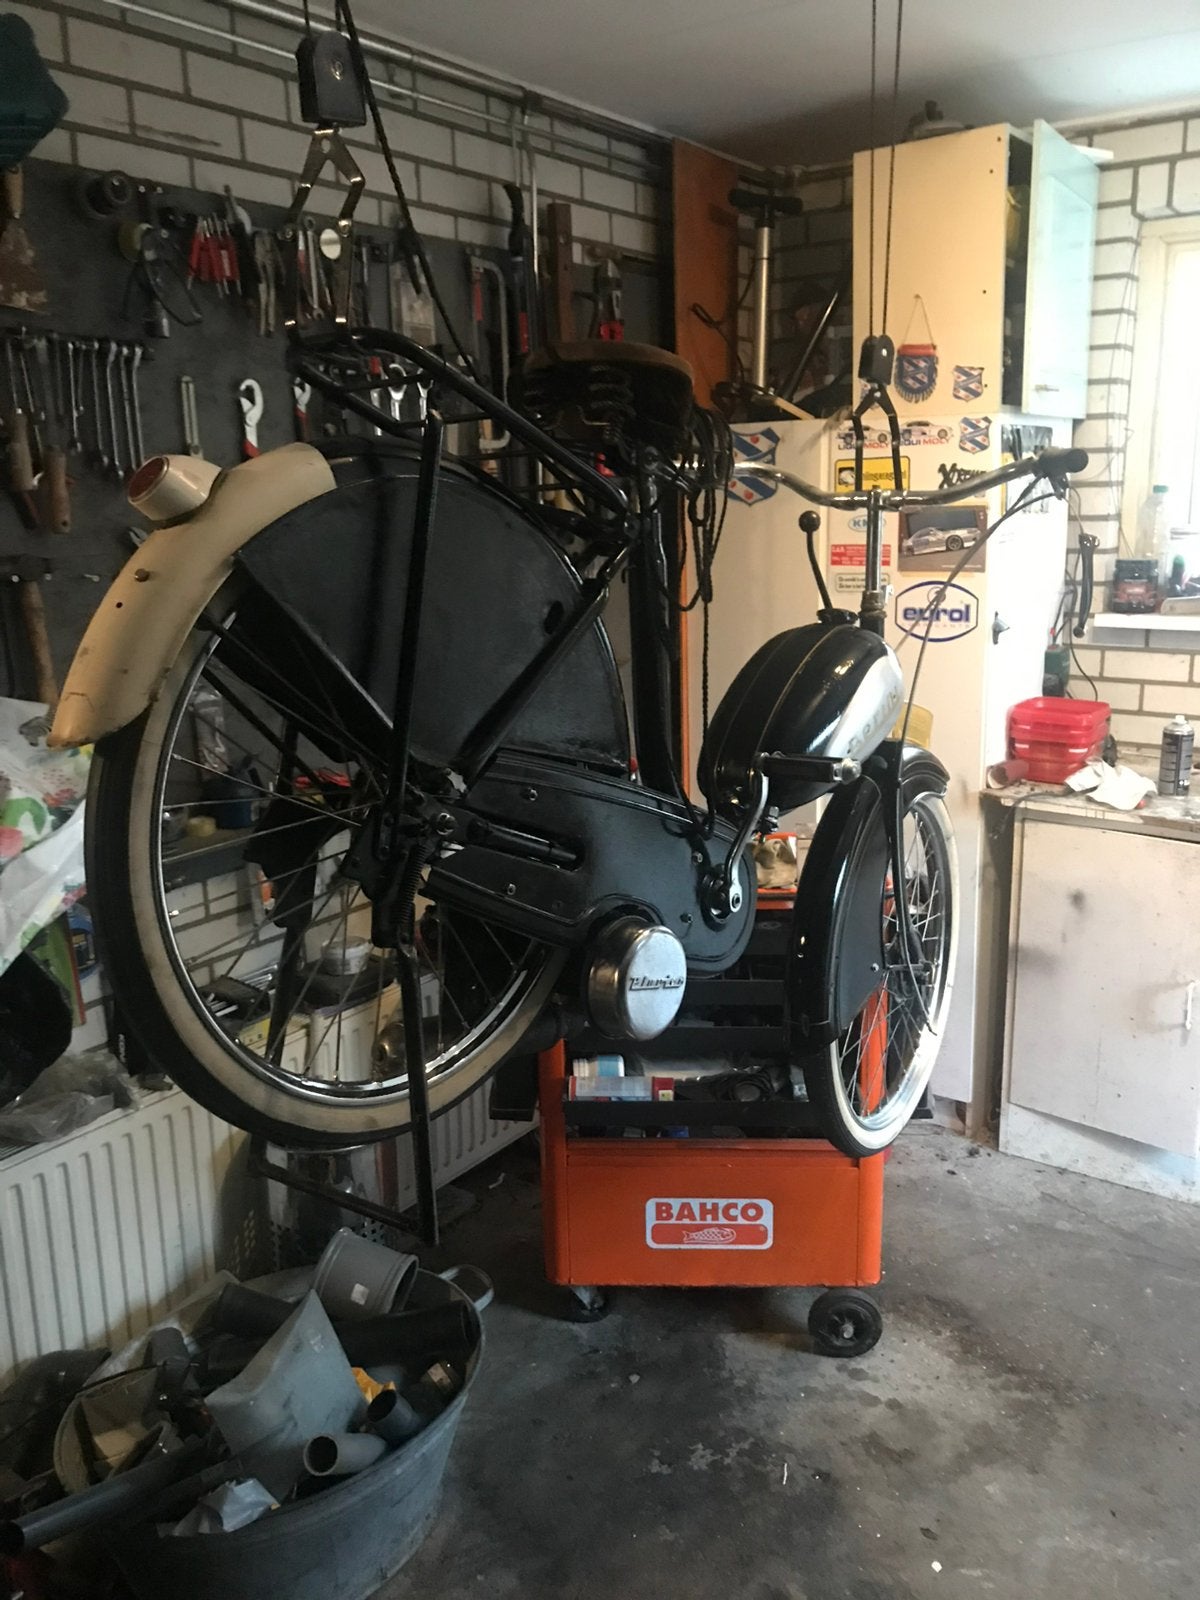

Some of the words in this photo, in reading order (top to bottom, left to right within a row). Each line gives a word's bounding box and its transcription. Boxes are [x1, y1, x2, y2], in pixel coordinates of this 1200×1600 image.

[863, 441, 889, 449] MOLY
[899, 438, 921, 446] IQUI
[923, 438, 950, 446] MOLY
[655, 1202, 764, 1222] BAHCO
